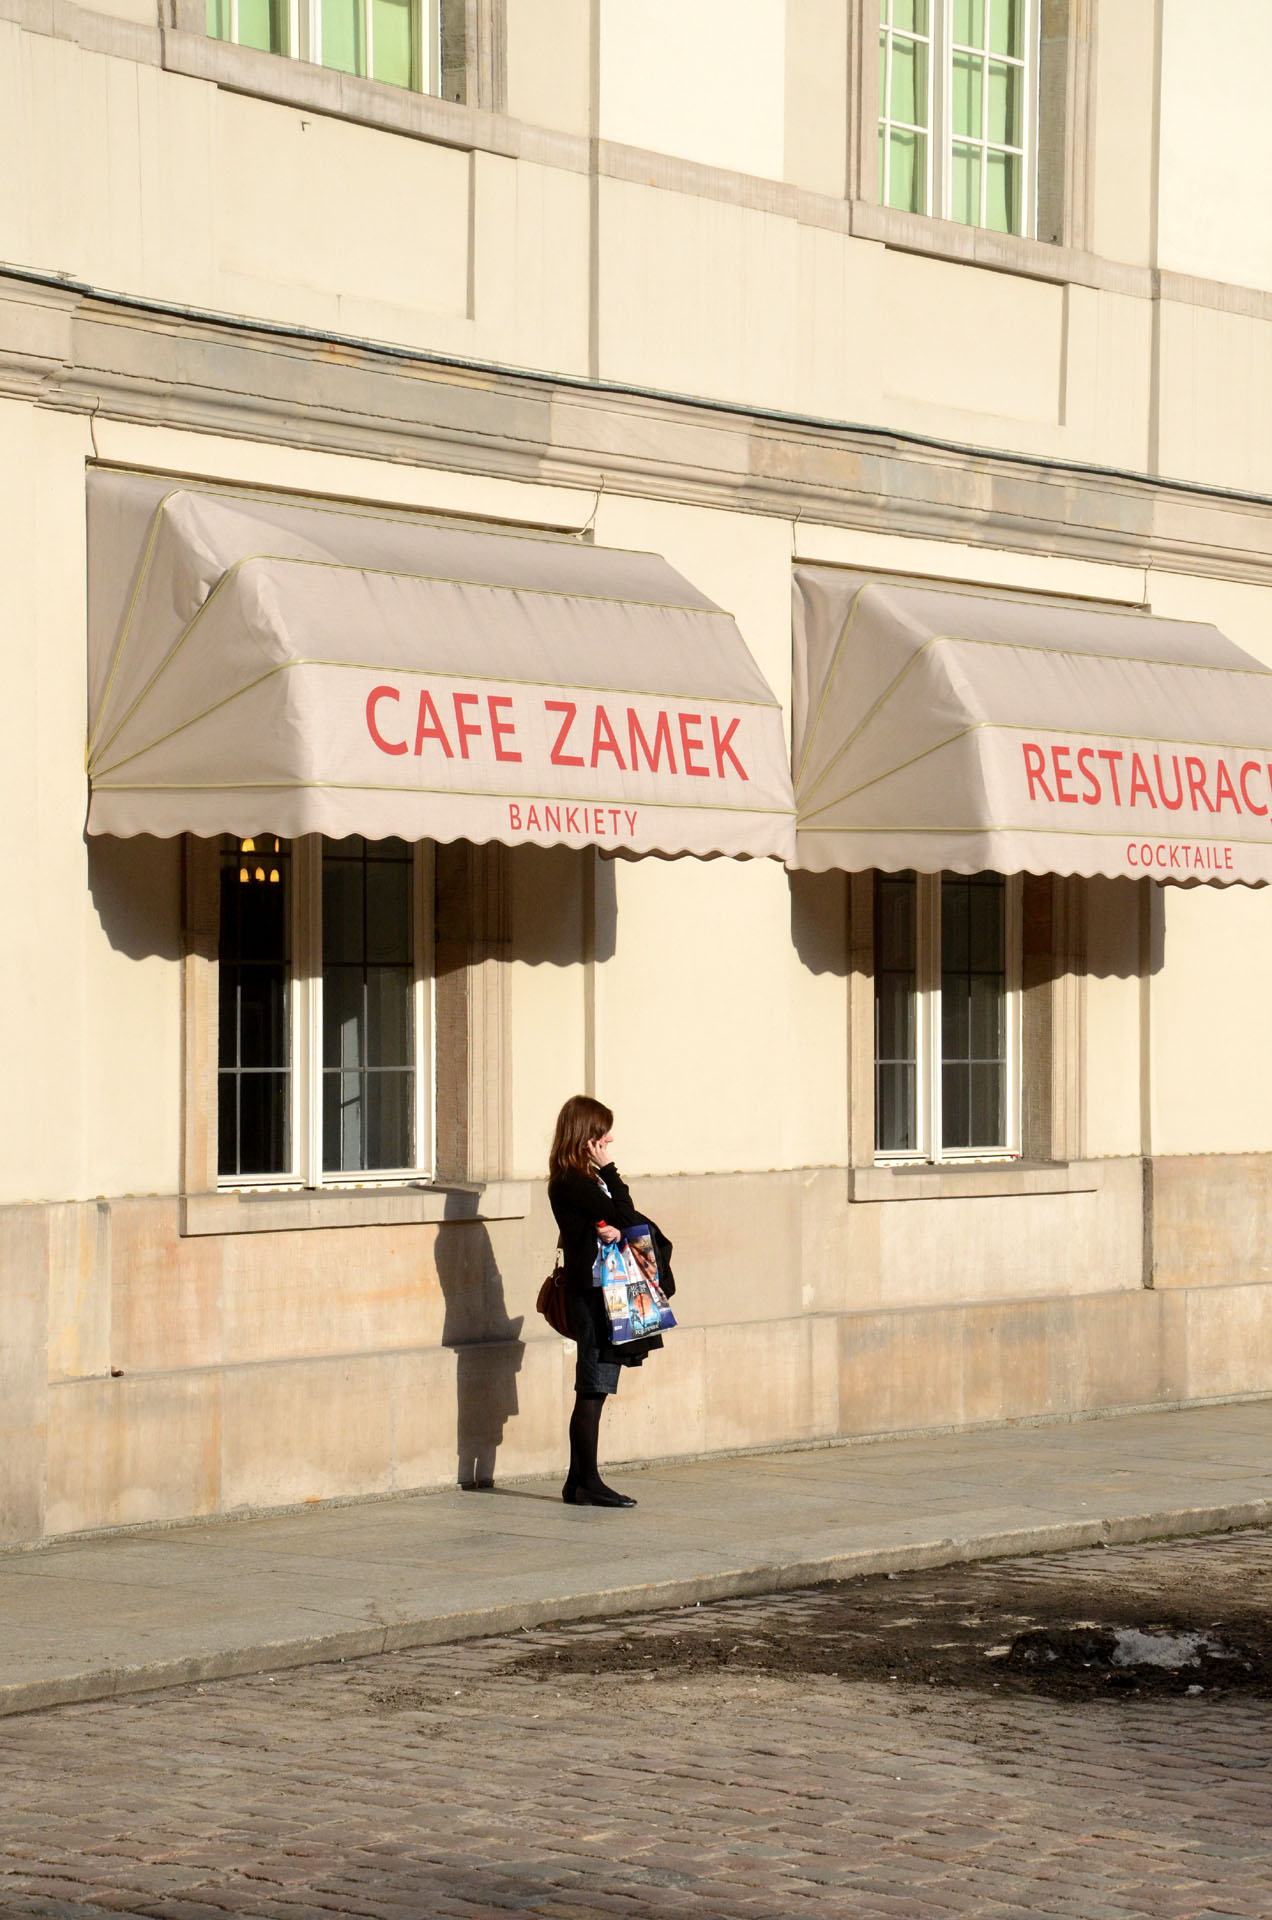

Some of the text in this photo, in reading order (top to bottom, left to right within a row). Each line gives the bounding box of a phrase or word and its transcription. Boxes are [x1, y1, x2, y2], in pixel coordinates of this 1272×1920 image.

[365, 684, 750, 781] CAFE ZAMEK
[509, 803, 638, 837] BANKIETY
[1127, 843, 1234, 869] COCKTAILE
